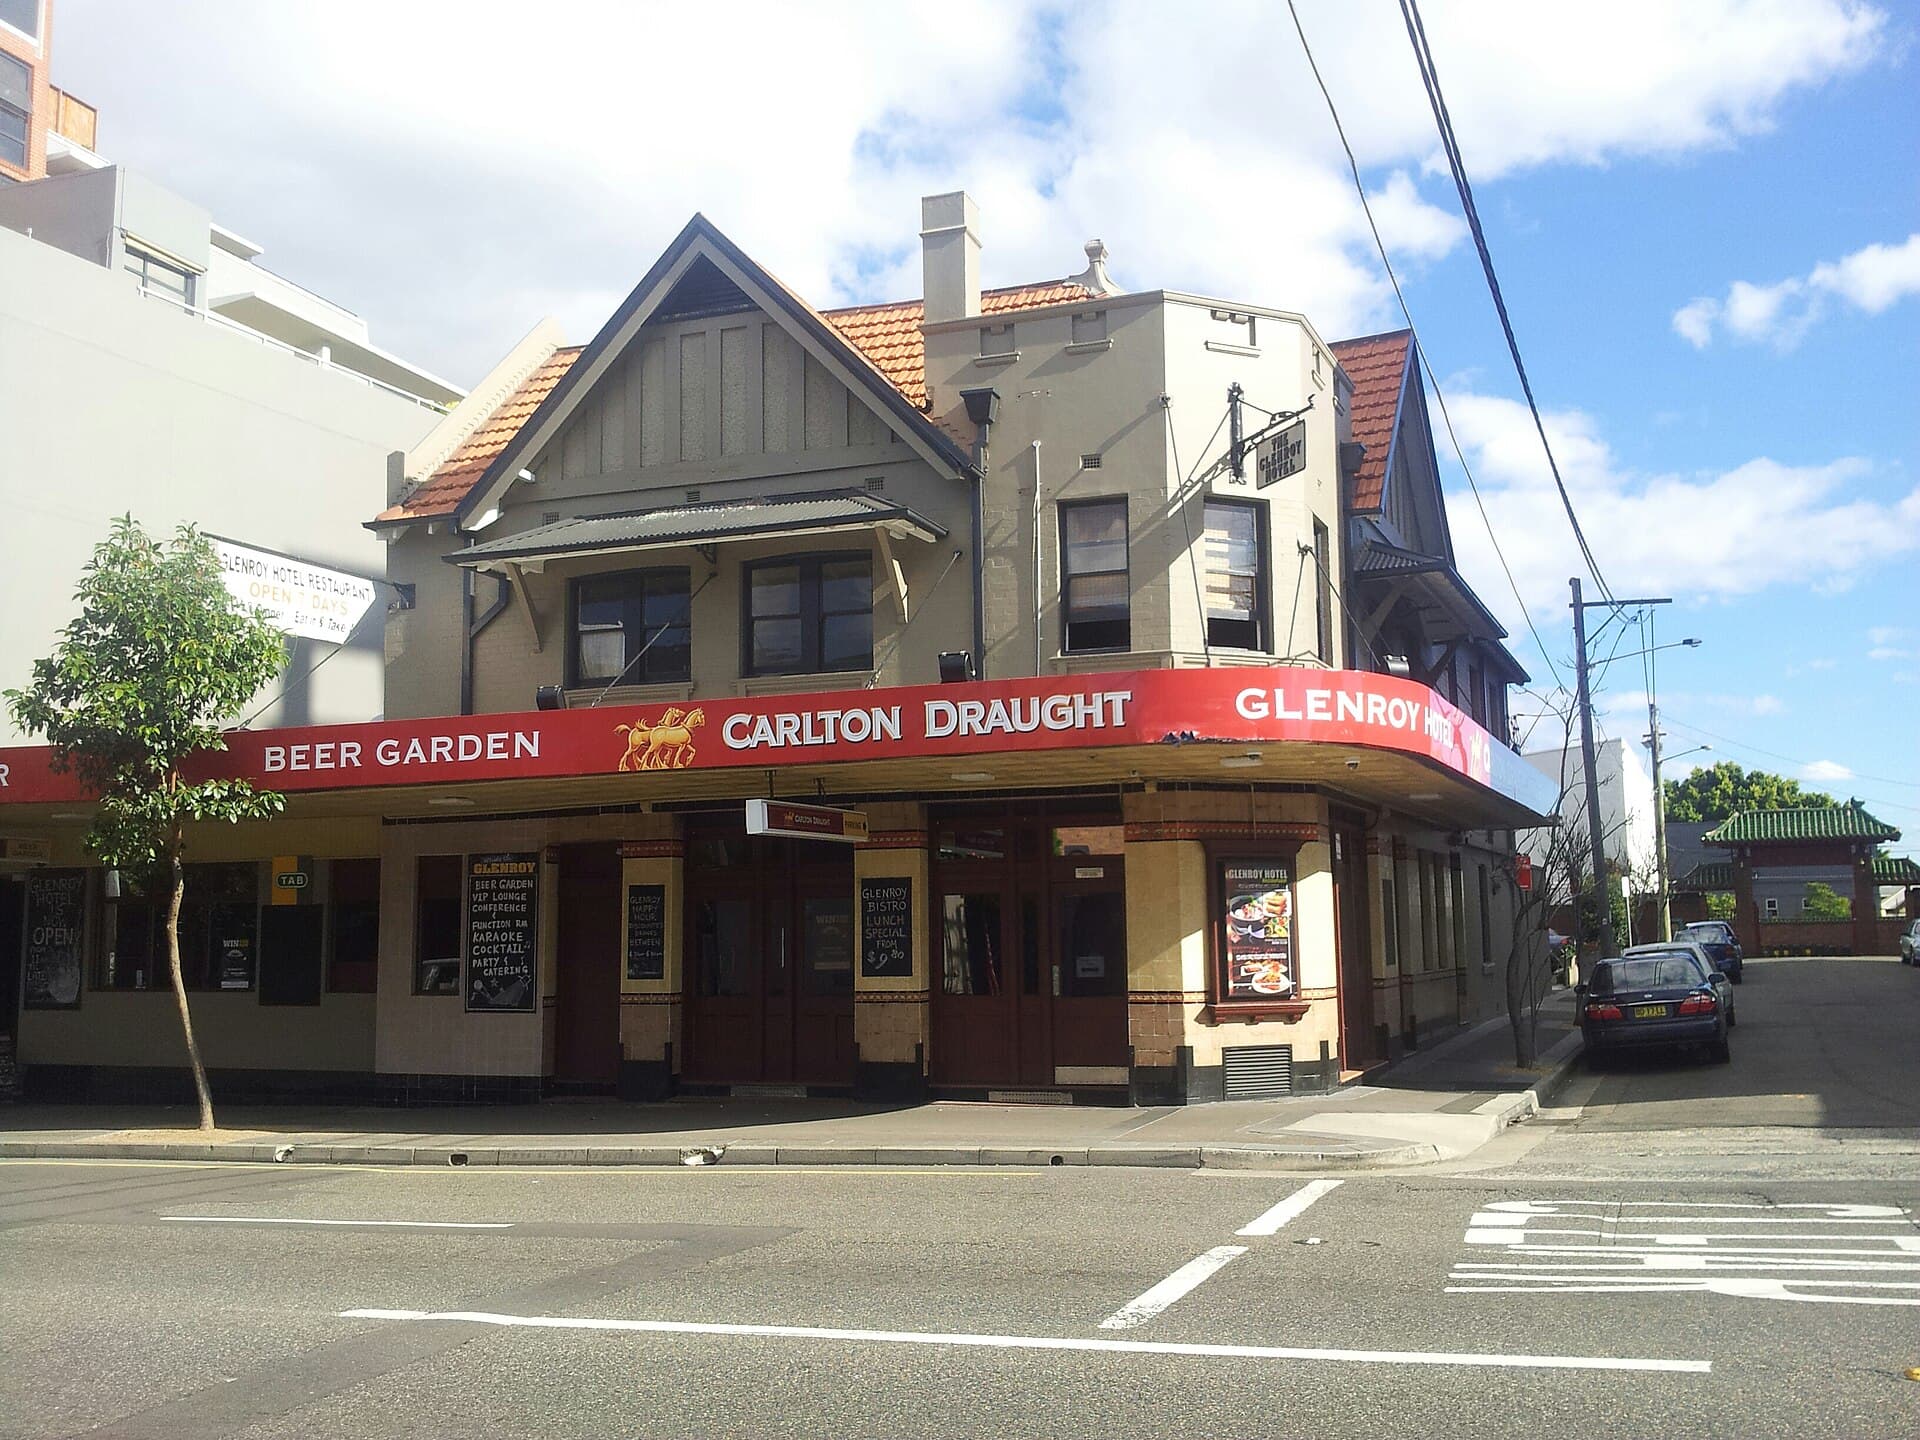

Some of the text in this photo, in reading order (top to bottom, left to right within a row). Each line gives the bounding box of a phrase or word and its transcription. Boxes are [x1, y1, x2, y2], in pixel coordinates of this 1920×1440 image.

[1271, 432, 1289, 452] THE
[1265, 459, 1296, 483] HOTEL
[273, 567, 305, 587] HOTEL
[309, 573, 371, 602] RESTAURANT
[249, 581, 292, 604] OPEN
[313, 595, 349, 616] DAYS
[721, 687, 1454, 752] CARLTON DRAUGHT GLENROY HOTEL
[264, 742, 362, 773] BEER
[376, 730, 541, 765] GARDEN
[473, 863, 536, 874] GLENROY
[1228, 868, 1288, 879] GLENROY HOTEL
[281, 875, 304, 885] TAB
[475, 878, 534, 890] BEER GARDEN
[472, 892, 527, 902] VIP LOUNGE
[862, 887, 907, 900] GLENROY
[472, 903, 527, 913] CONFERENCE
[867, 900, 907, 913] BISTRO
[472, 920, 511, 931] FUNCTION
[867, 914, 905, 927] LUNCH
[33, 927, 73, 945] OPEN
[472, 931, 524, 943] KARAOKE
[866, 927, 906, 939] SPECIAL
[472, 943, 525, 955] COCKTAIL
[472, 956, 500, 968] PARTY
[483, 965, 529, 977] CATERING
